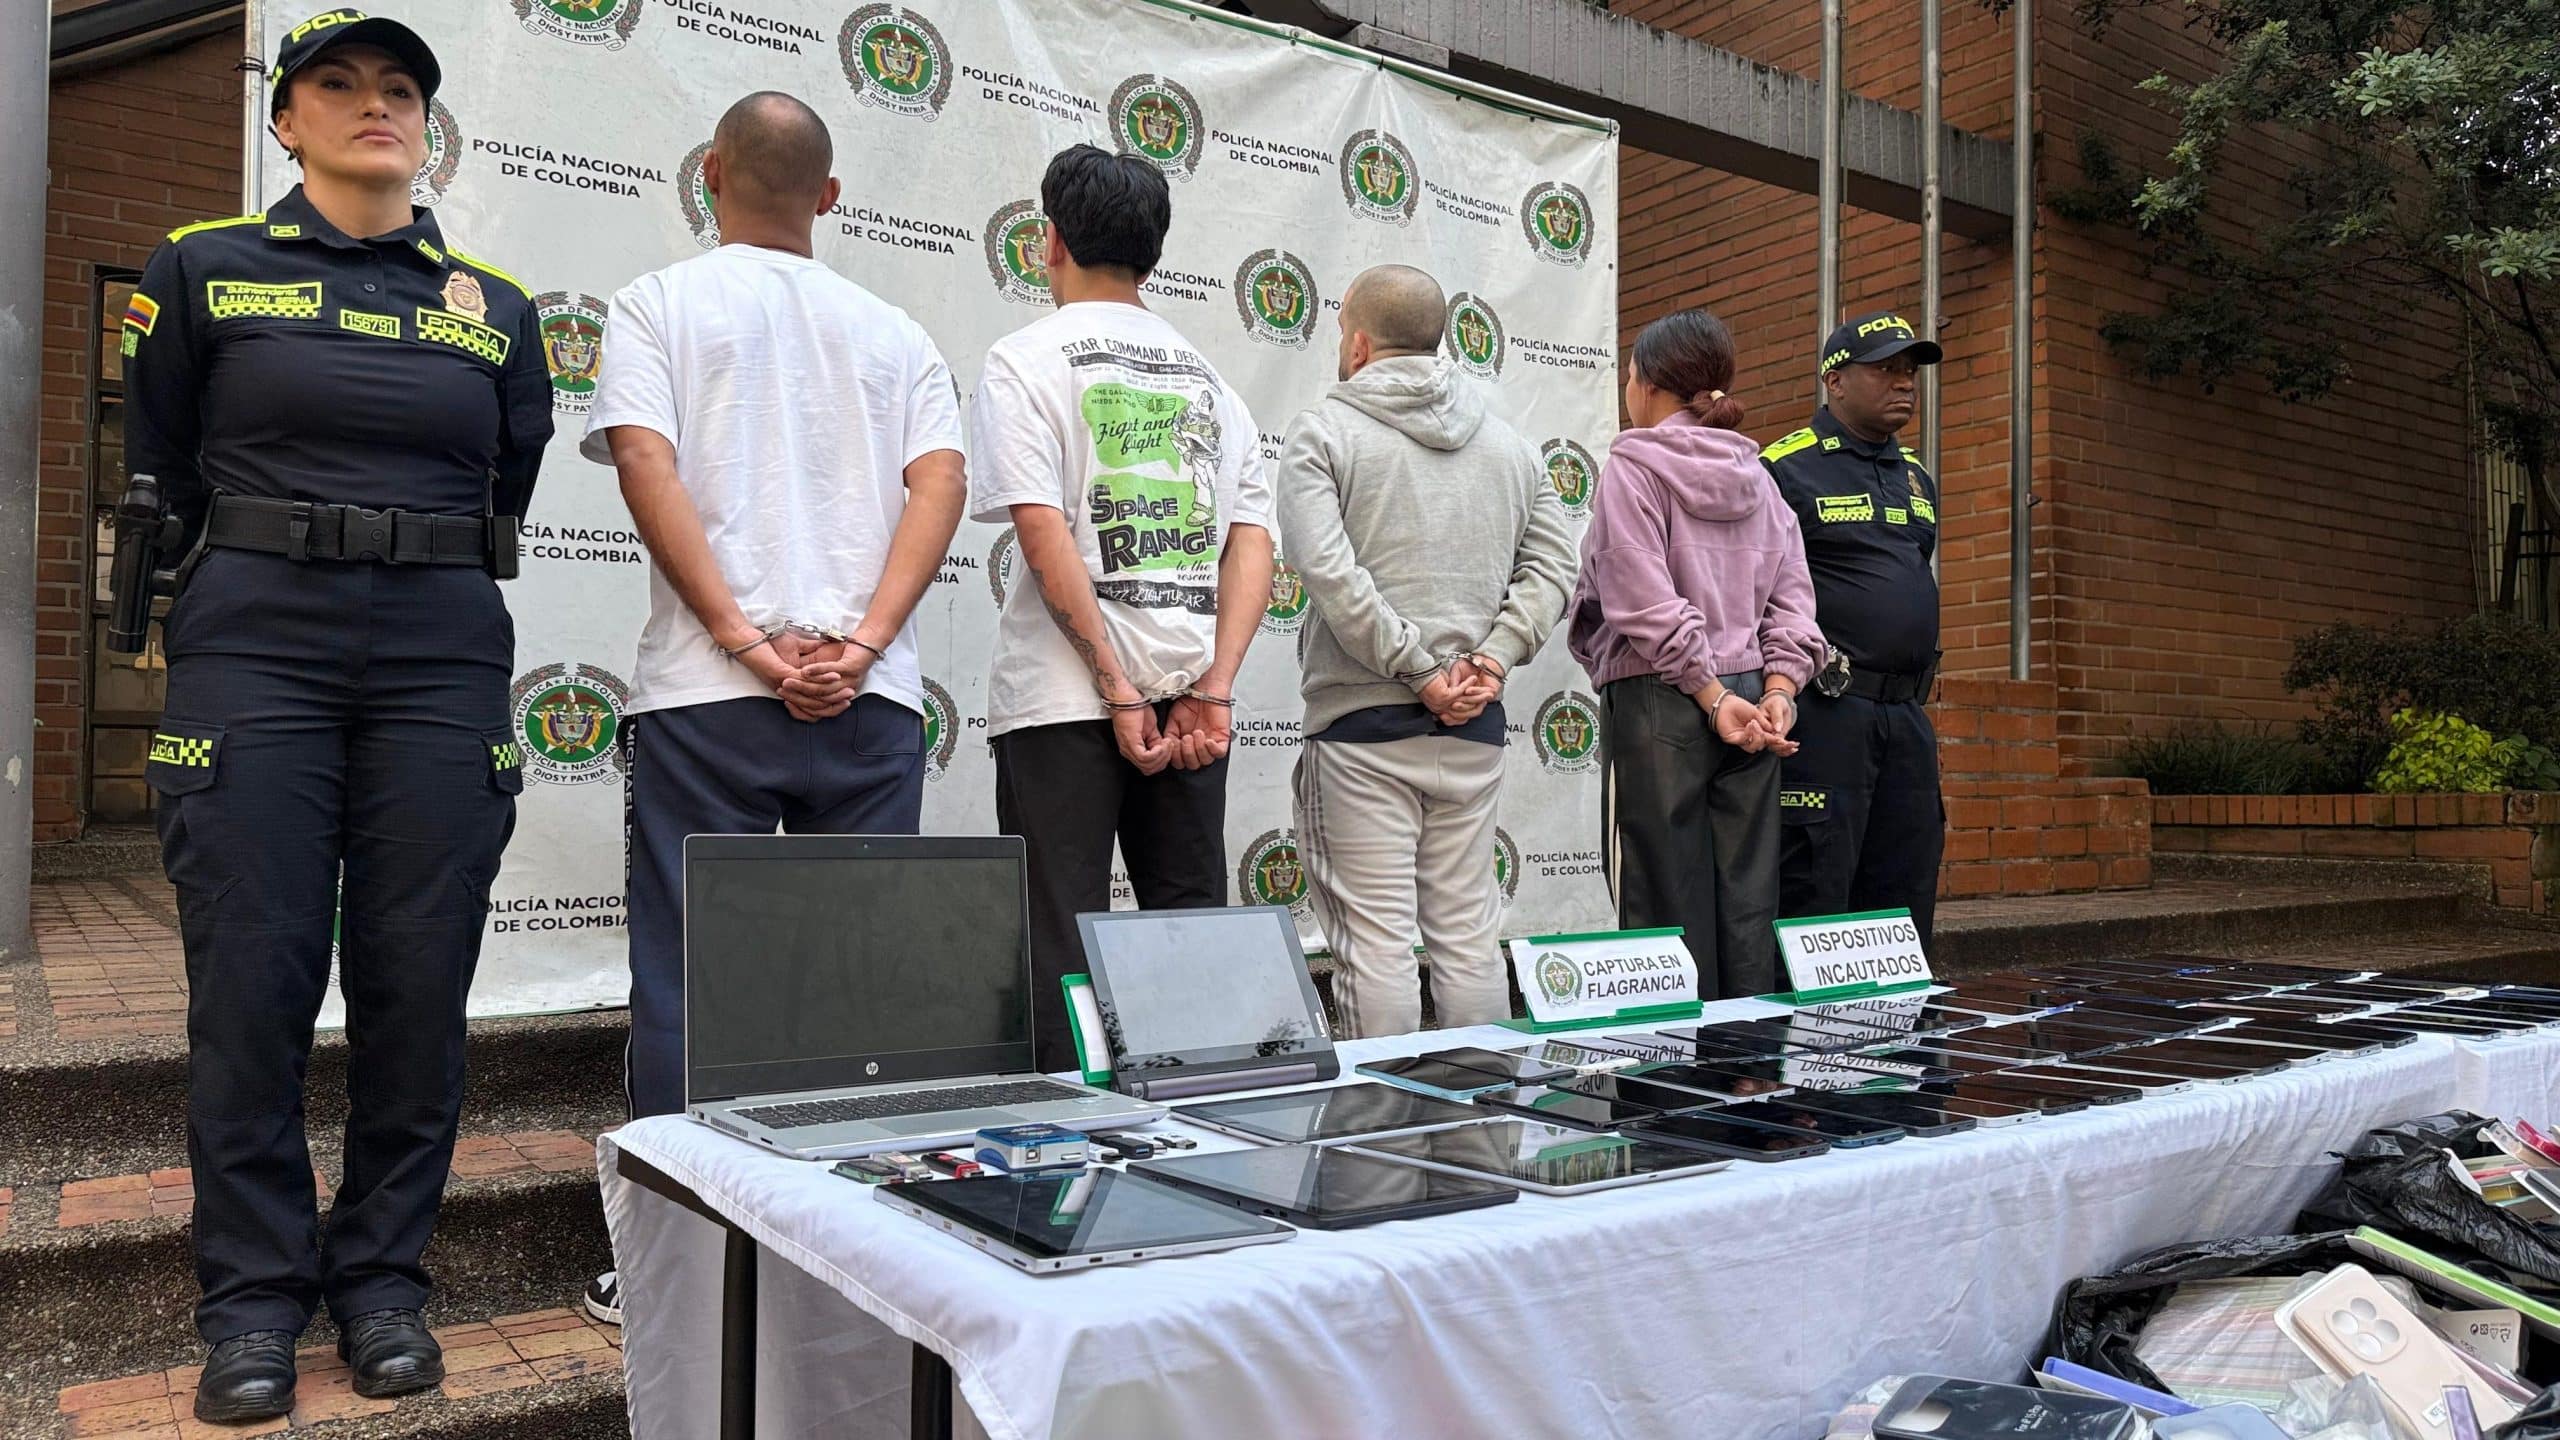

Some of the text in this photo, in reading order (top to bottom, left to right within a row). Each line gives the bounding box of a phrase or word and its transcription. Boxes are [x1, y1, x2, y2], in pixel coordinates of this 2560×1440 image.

[538, 18, 610, 42] DIOS Y PATRIA
[575, 9, 622, 30] NACIONAL
[664, 0, 826, 43] OLICÍA NACIONAL
[677, 15, 802, 55] DE COLOMBIA
[892, 17, 905, 26] DE
[913, 27, 940, 76] COLOMBIA
[899, 84, 936, 102] NACIONAL
[962, 66, 1101, 113] POLICÍA NACIONAL
[1155, 86, 1167, 95] DE
[869, 92, 891, 109] DIOS
[898, 104, 927, 114] PATRIA
[983, 88, 1083, 124] DE COLOMBIA
[1212, 130, 1335, 165] POLICÍA NACIONAL
[473, 138, 556, 164] POLICÍA
[561, 154, 667, 183] NACIONAL
[1230, 150, 1320, 176] DE COLOMBIA
[501, 162, 641, 198] DE COLOMBIA
[1424, 180, 1514, 216] POLICÍA NACIONAL
[830, 203, 975, 242] OLICÍA NACIONAL
[1436, 199, 1501, 227] DE COLOMBIA
[841, 223, 955, 255] DE COLOMBIA
[1153, 269, 1226, 289] NACIONAL
[1011, 288, 1032, 302] DIOS
[1039, 297, 1056, 305] PAT
[568, 305, 582, 315] DE
[347, 313, 396, 335] 156791
[427, 315, 501, 350] POLICÍA
[1062, 337, 1168, 362] STAR COMMAND
[1511, 336, 1611, 358] POLICÍA NACIONAL
[1524, 352, 1596, 370] DE COLOMBIA
[573, 403, 591, 412] PAT
[1143, 411, 1177, 431] and
[561, 527, 642, 544] NACION
[519, 544, 642, 564] E COLOMBIA
[1176, 560, 1211, 571] to the
[1240, 737, 1303, 746] DE COLOM
[534, 769, 559, 782] DIOS
[571, 769, 608, 783] PATRIA
[625, 724, 636, 816] MICHAEL
[1526, 851, 1570, 864] POLICÍA
[1542, 865, 1601, 876] DE COLOM
[1112, 888, 1131, 898] DE
[494, 919, 520, 933] DE
[1800, 923, 1917, 954] DISPOSITIVOS
[1583, 954, 1682, 976] CAPTURA EN
[1815, 954, 1922, 986] INCAUTADOS
[1588, 974, 1686, 999] FLAGRANCIA
